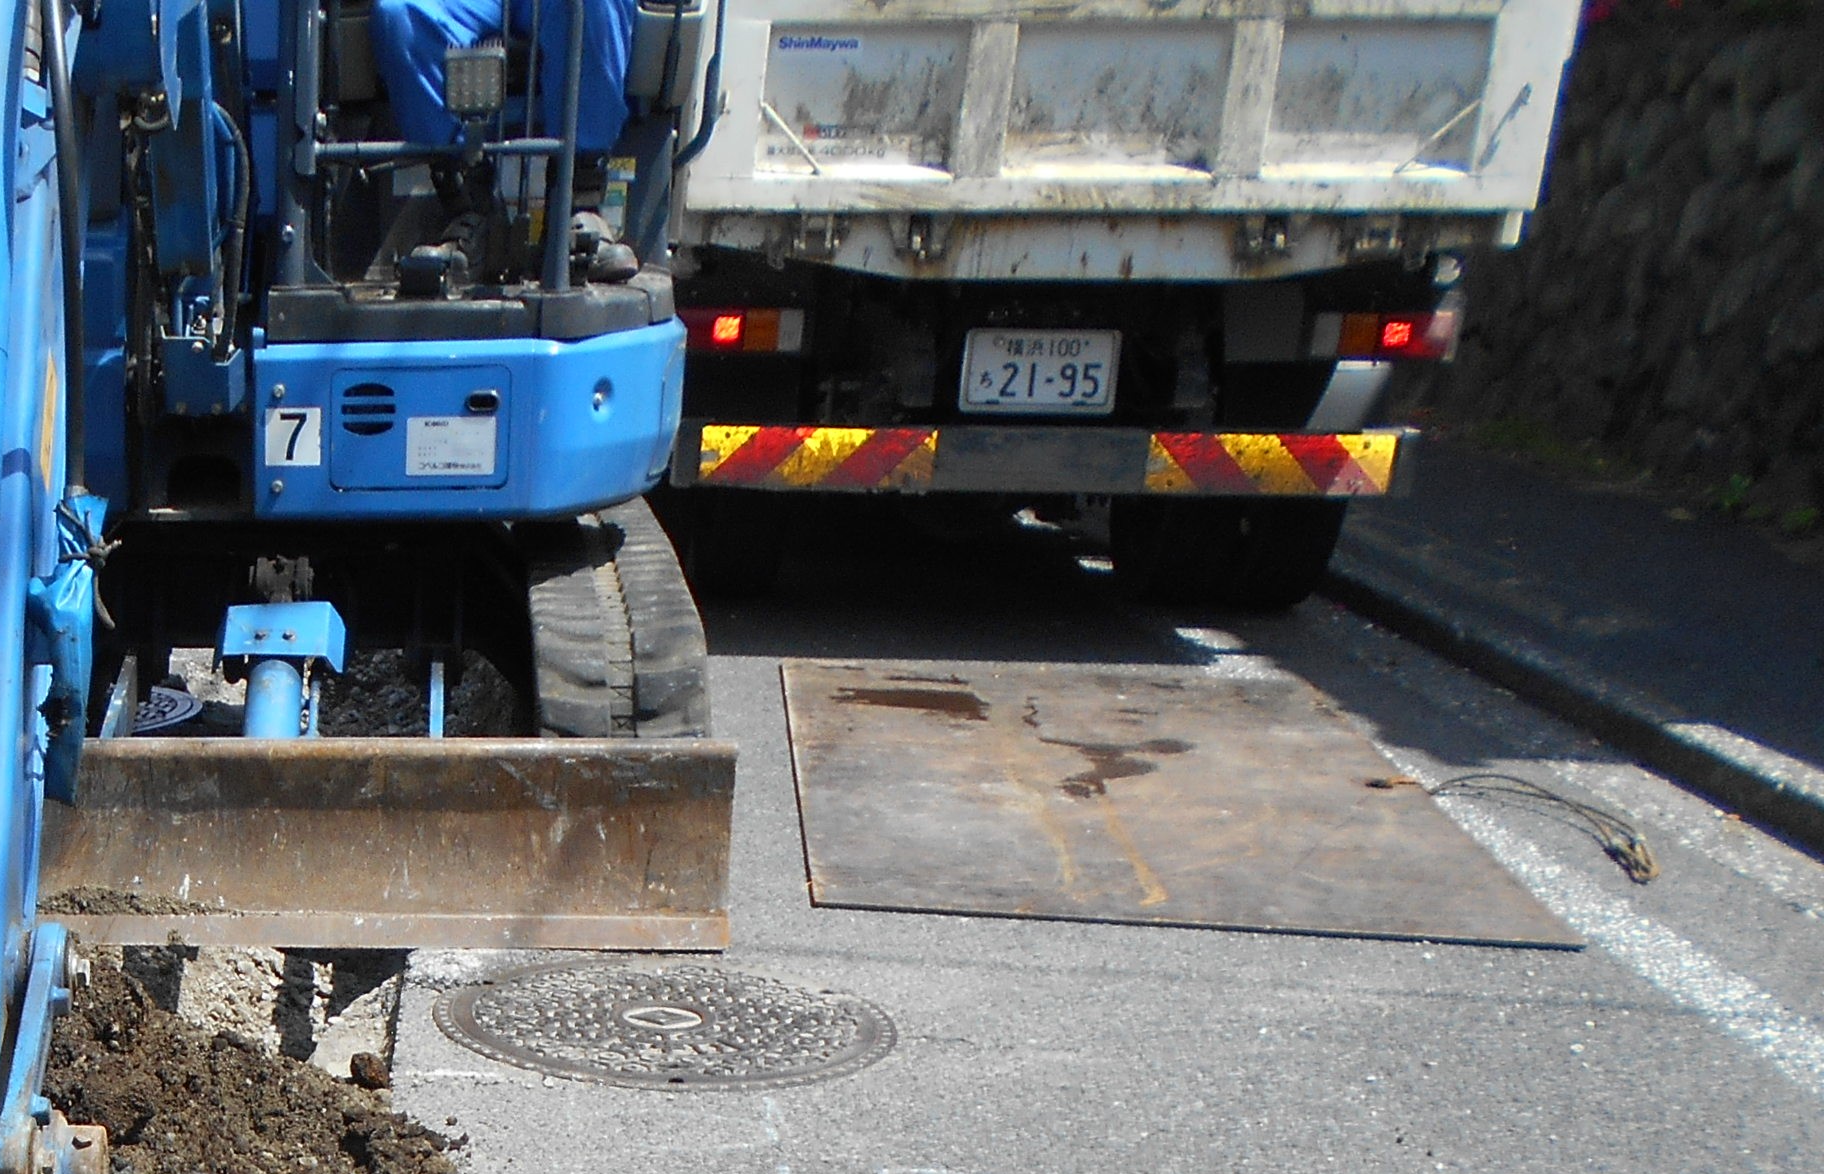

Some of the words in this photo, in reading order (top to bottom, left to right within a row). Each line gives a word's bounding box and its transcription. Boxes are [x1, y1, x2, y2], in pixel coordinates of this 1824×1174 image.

[778, 36, 860, 52] ShinMaywa
[998, 361, 1103, 399] 21-95
[278, 412, 308, 461] 7
